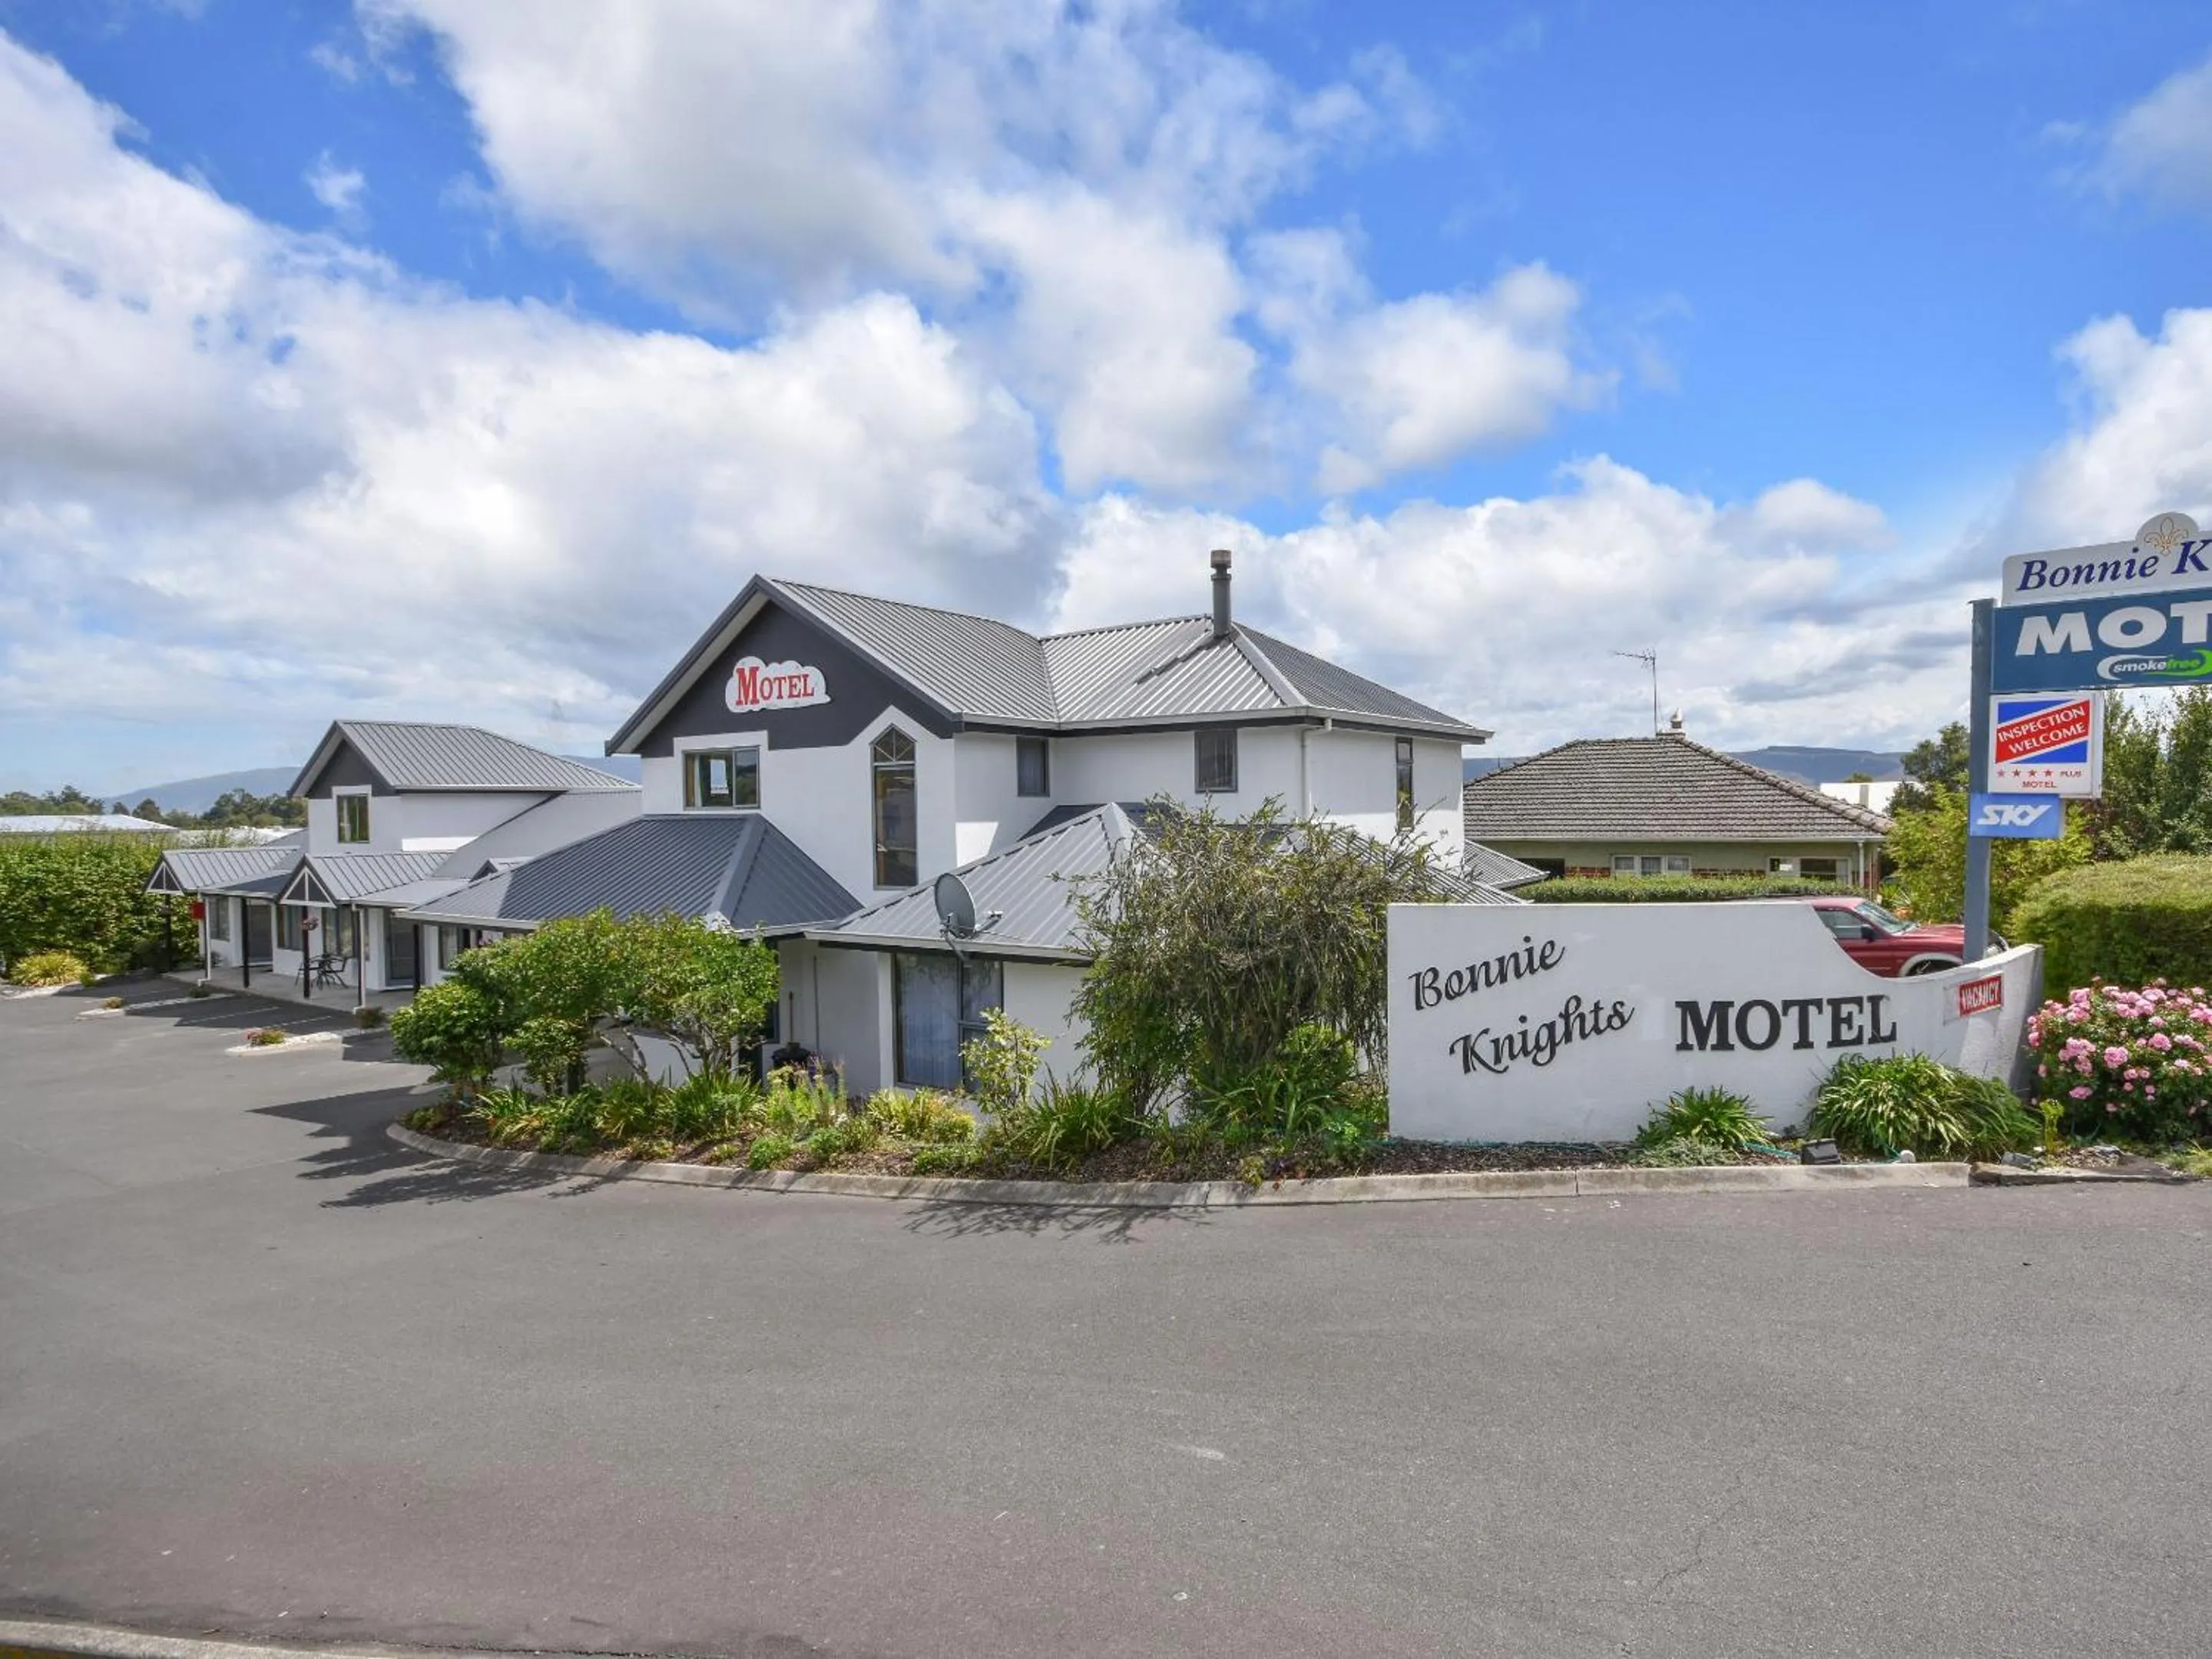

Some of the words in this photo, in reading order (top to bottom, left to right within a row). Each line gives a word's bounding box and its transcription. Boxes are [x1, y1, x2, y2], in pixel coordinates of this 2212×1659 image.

[2015, 547, 2159, 591] Bonnie
[2015, 600, 2212, 656] MOT
[736, 666, 815, 706] MOTEL
[1998, 706, 2085, 742] INSPECTION
[2008, 722, 2086, 755] WELCOME
[1977, 805, 2052, 826] SKY
[1408, 935, 1565, 1011] Bonnie
[1962, 980, 2000, 1010] VACANCY
[1449, 995, 1635, 1075] Knights
[1675, 995, 1897, 1051] MOTEL
